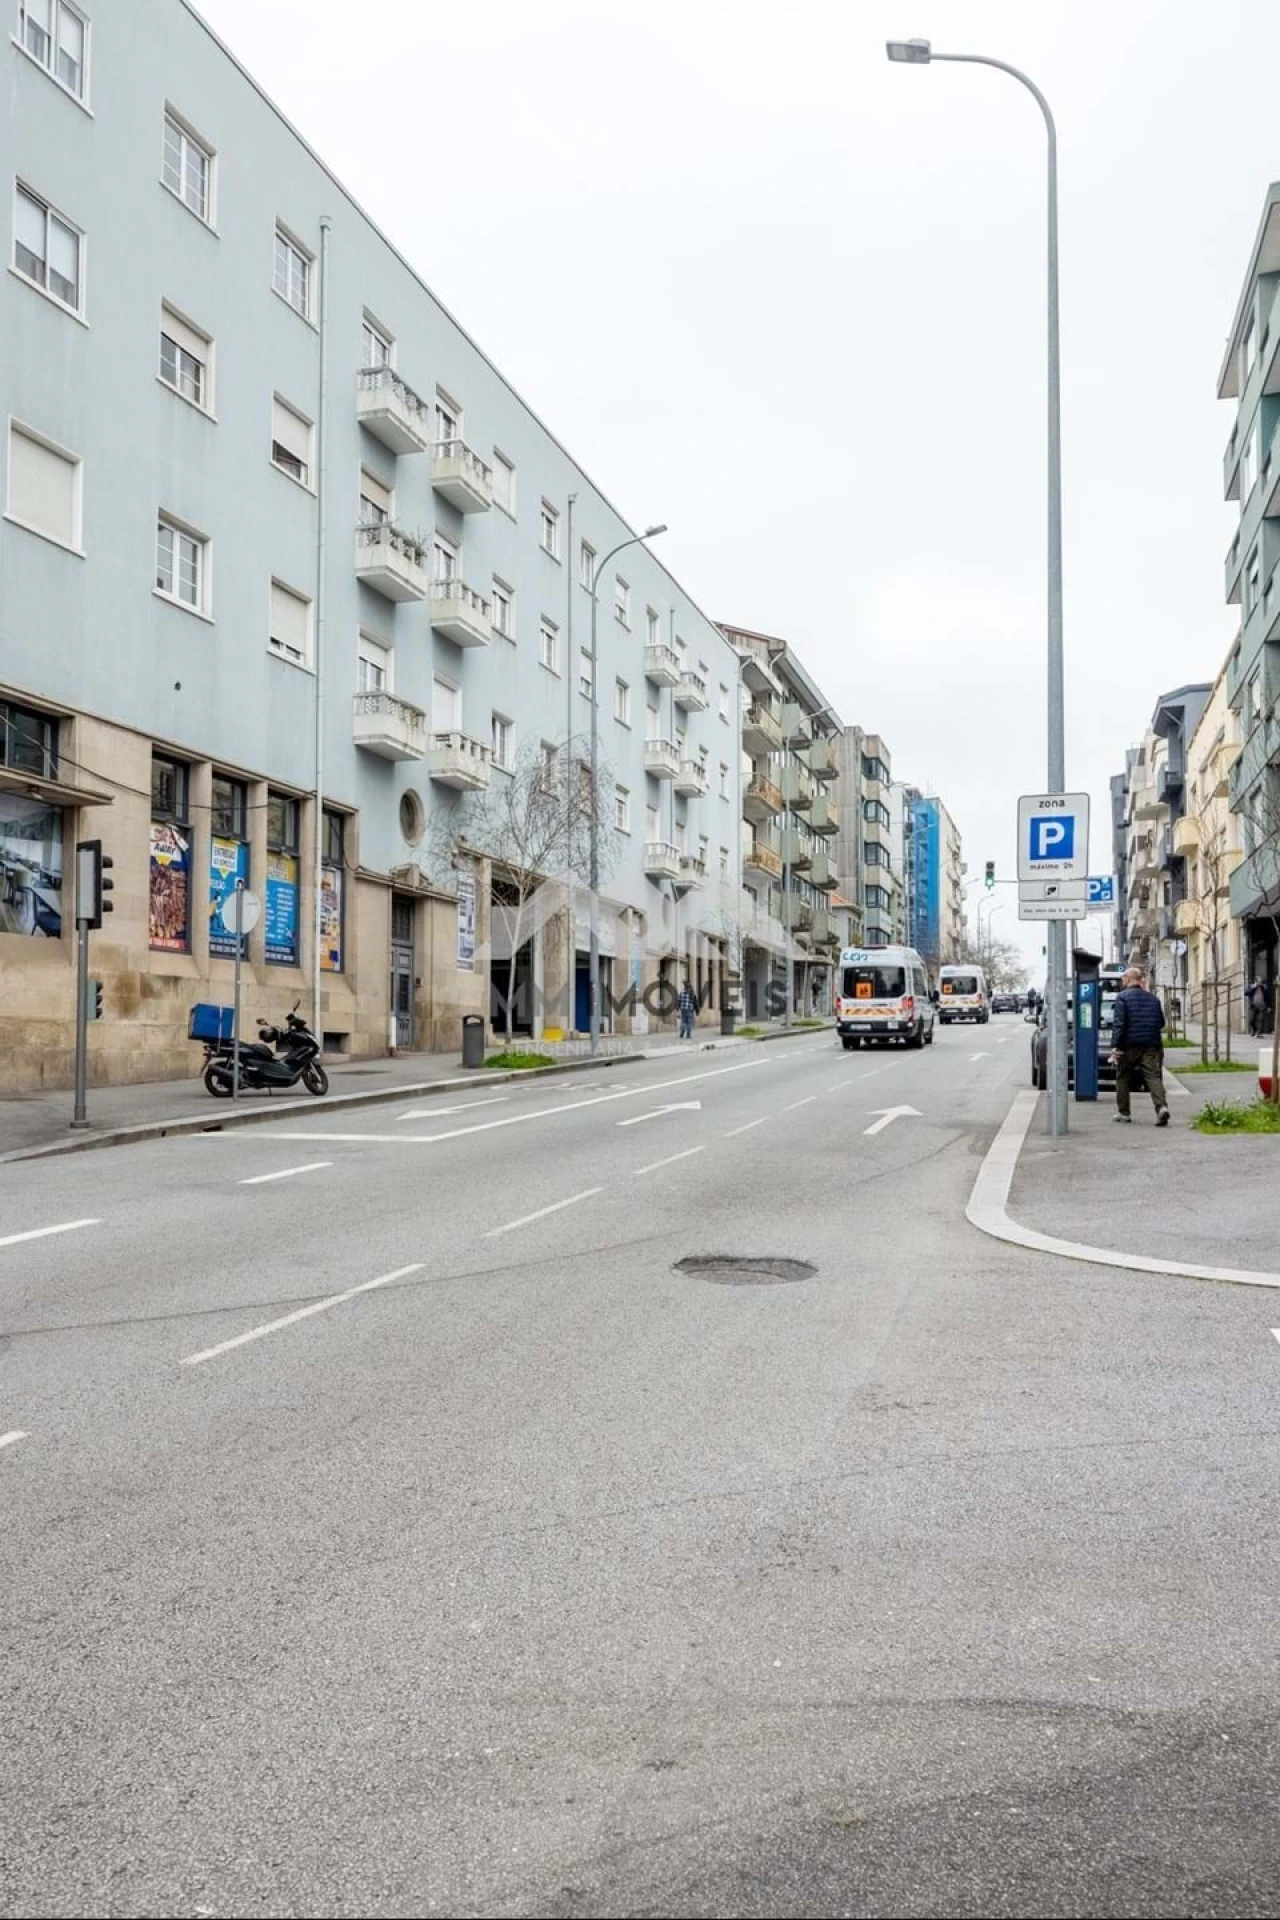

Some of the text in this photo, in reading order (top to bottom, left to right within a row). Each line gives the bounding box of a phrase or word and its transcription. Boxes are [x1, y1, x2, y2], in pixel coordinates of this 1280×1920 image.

[1039, 799, 1065, 809] zona
[1039, 821, 1065, 857] P
[1088, 880, 1101, 901] P
[1080, 983, 1090, 997] P
